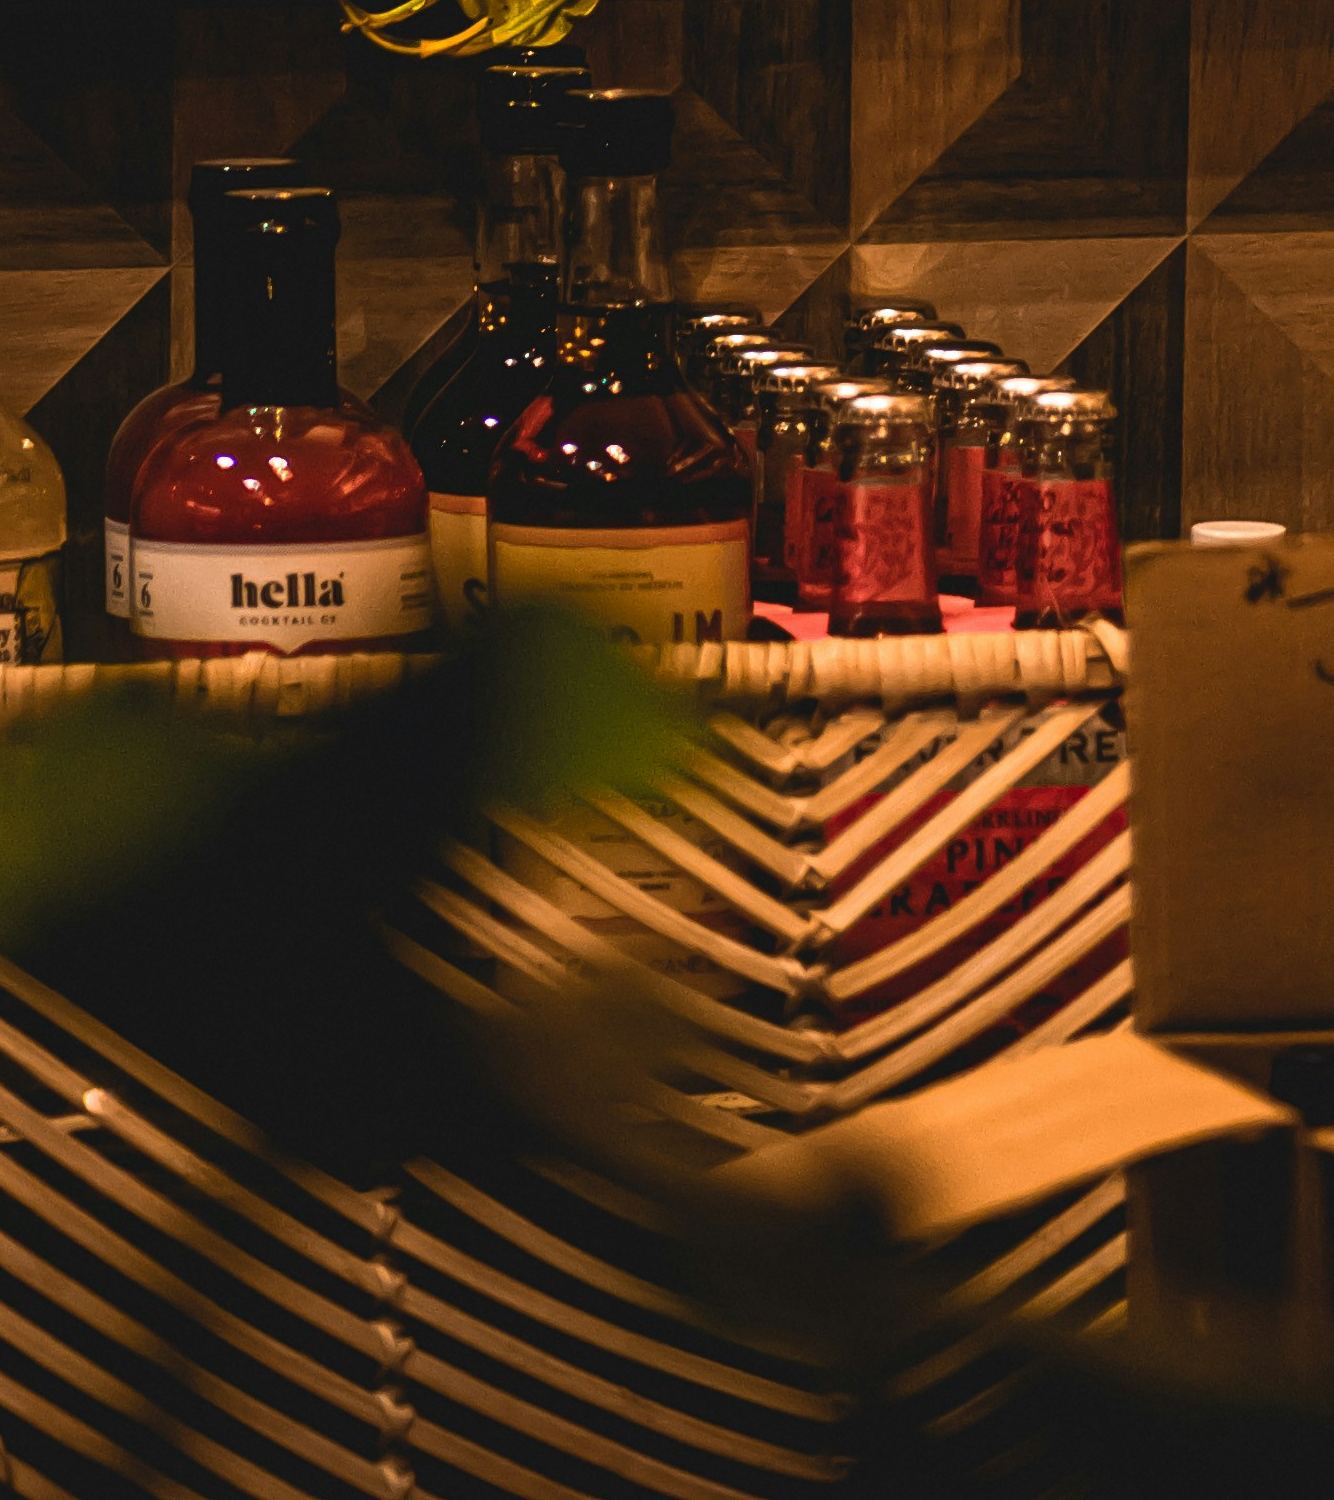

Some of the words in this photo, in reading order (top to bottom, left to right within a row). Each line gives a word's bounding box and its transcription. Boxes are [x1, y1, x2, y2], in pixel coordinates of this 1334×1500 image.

[140, 581, 152, 609] 6
[230, 572, 345, 609] hella
[239, 615, 315, 626] COCKTAIL
